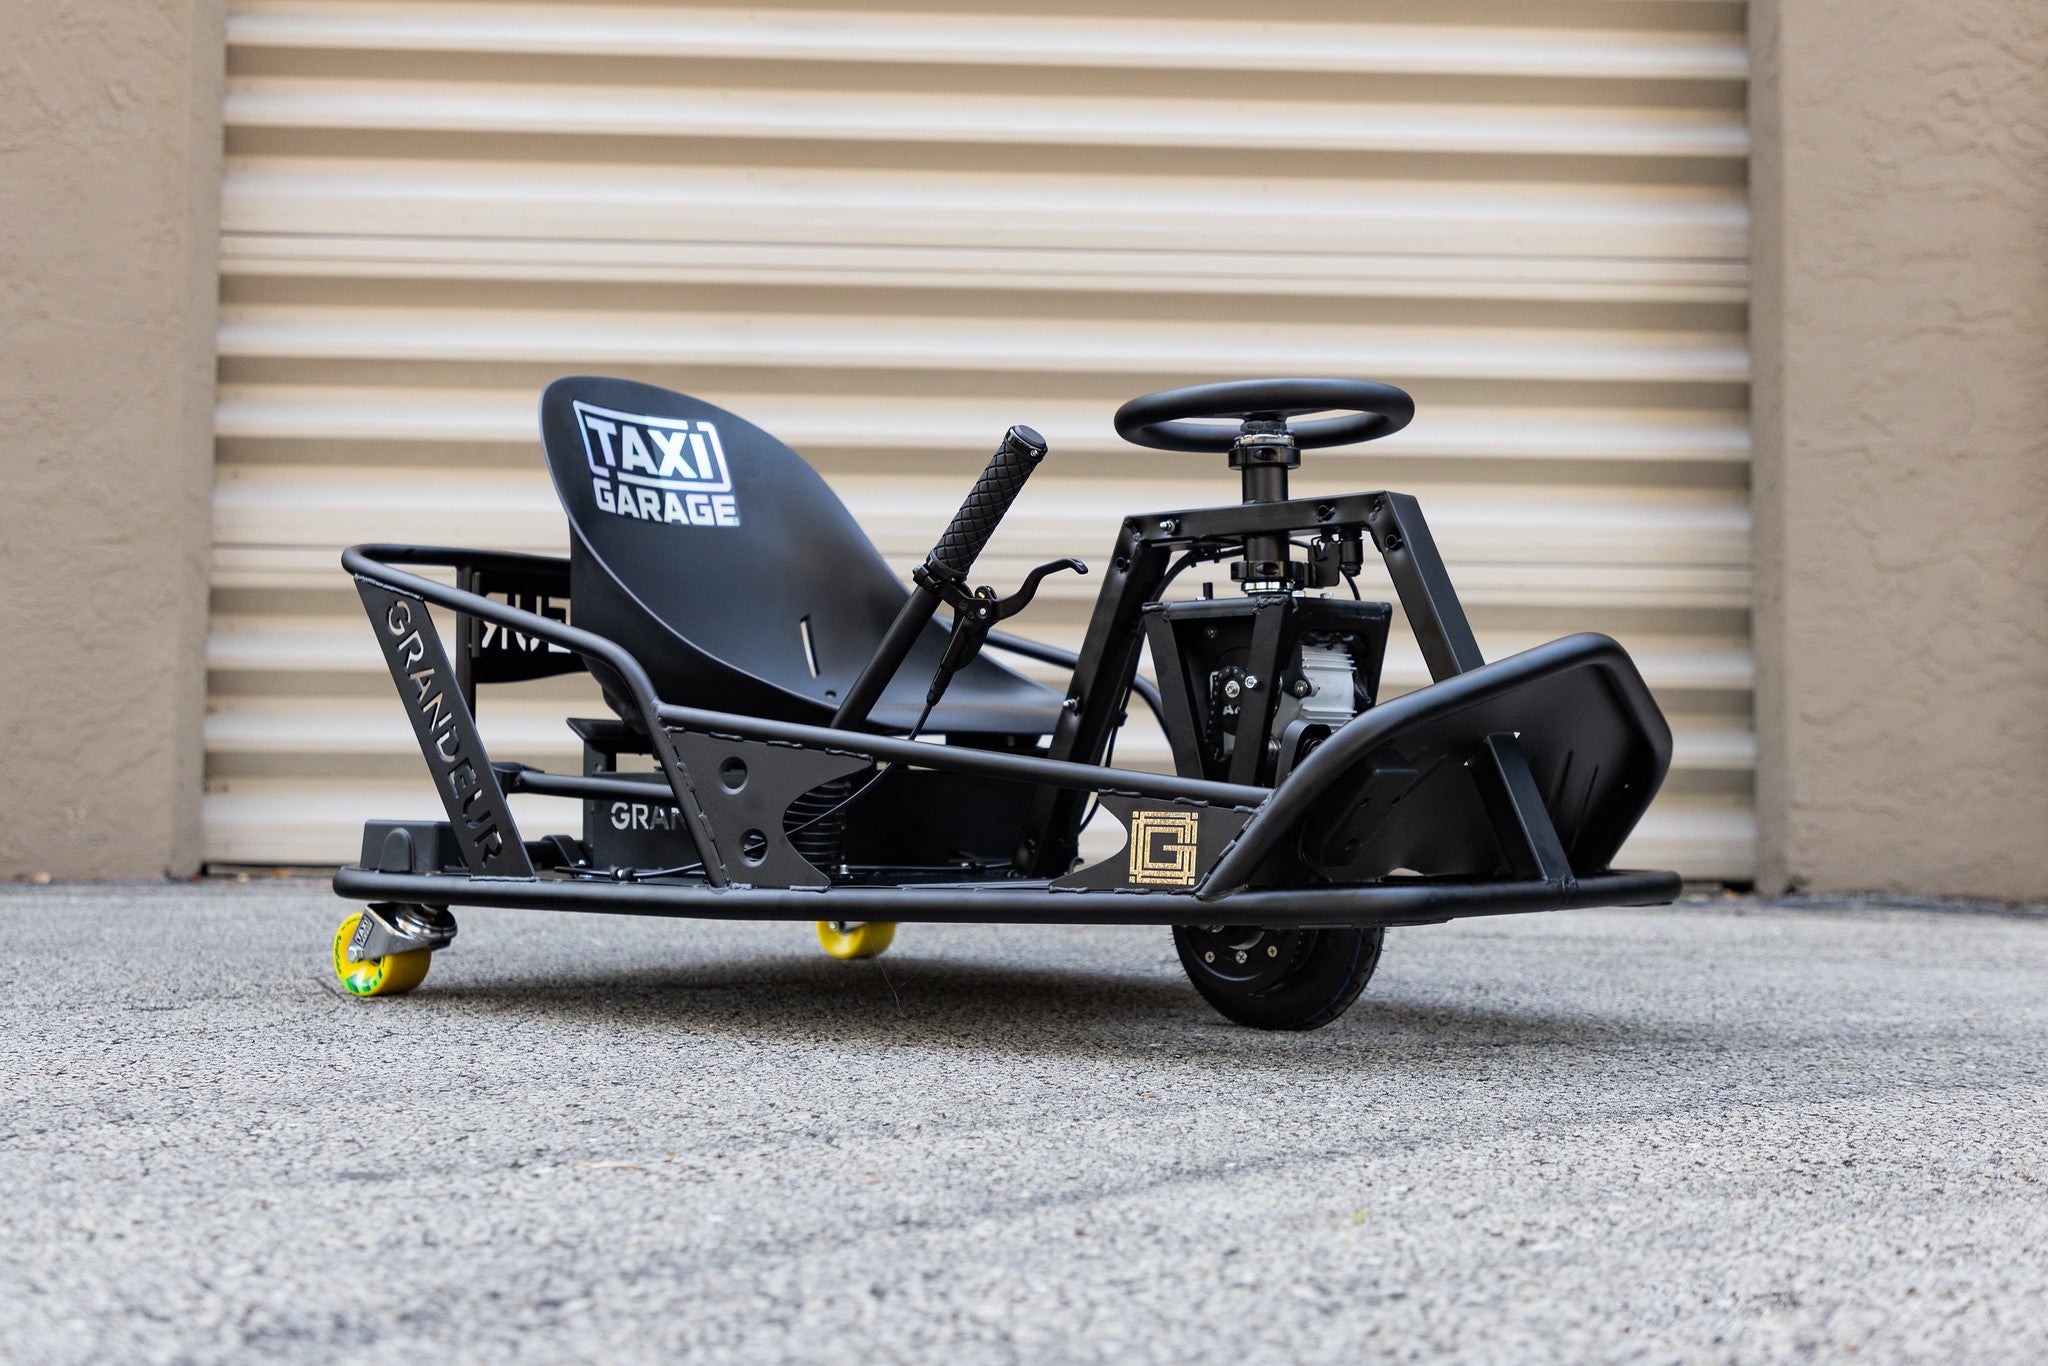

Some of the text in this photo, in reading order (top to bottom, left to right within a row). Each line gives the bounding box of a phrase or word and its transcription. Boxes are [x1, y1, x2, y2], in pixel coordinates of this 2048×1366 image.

[585, 415, 713, 479] TAXI
[593, 477, 740, 527] GARAGE
[386, 600, 503, 869] GRANDEUR
